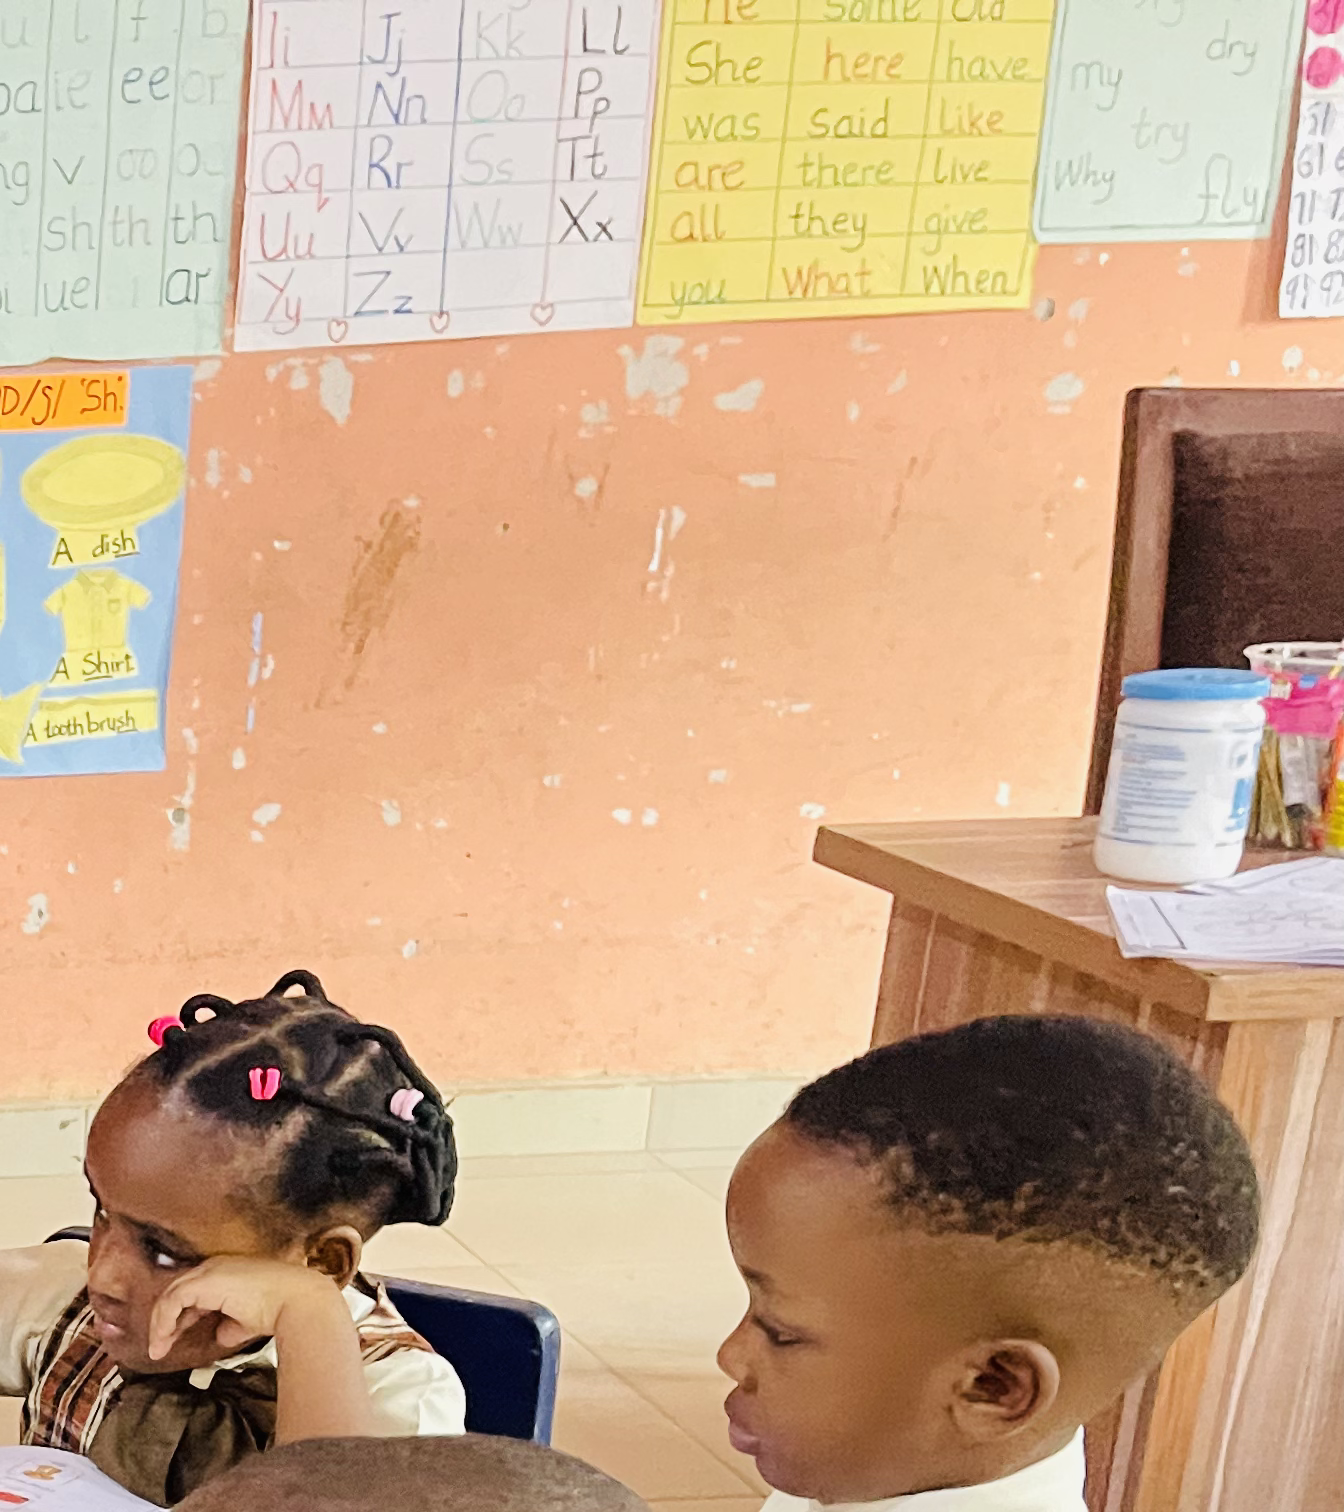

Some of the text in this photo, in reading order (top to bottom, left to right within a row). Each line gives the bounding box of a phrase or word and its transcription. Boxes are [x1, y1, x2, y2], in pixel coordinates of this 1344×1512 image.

[366, 12, 406, 77] Jj
[685, 37, 1029, 86] She here have
[1207, 19, 1262, 76] dry
[121, 66, 169, 103] ee
[269, 77, 333, 130] Mm
[367, 77, 427, 126] Nn
[576, 67, 610, 133] Pp
[1071, 61, 1122, 111] my
[683, 112, 760, 142] was
[939, 100, 1004, 136] like
[1132, 107, 1189, 164] try
[52, 156, 85, 185] v
[261, 141, 329, 212] Qq
[368, 135, 414, 189] Rr
[558, 134, 607, 181] Tt
[675, 148, 990, 192] are there live
[1054, 152, 1115, 205] Why
[110, 205, 151, 246] th
[172, 201, 221, 244] th
[260, 212, 315, 261] Uu
[359, 207, 412, 253] Vv
[558, 190, 613, 244] Xx
[671, 200, 988, 255] all they give
[43, 277, 91, 311] ue
[166, 269, 211, 305] ar
[258, 268, 413, 335] Yy Zz
[664, 254, 1009, 319] you What When
[52, 534, 140, 566] A dish
[50, 657, 70, 682] A
